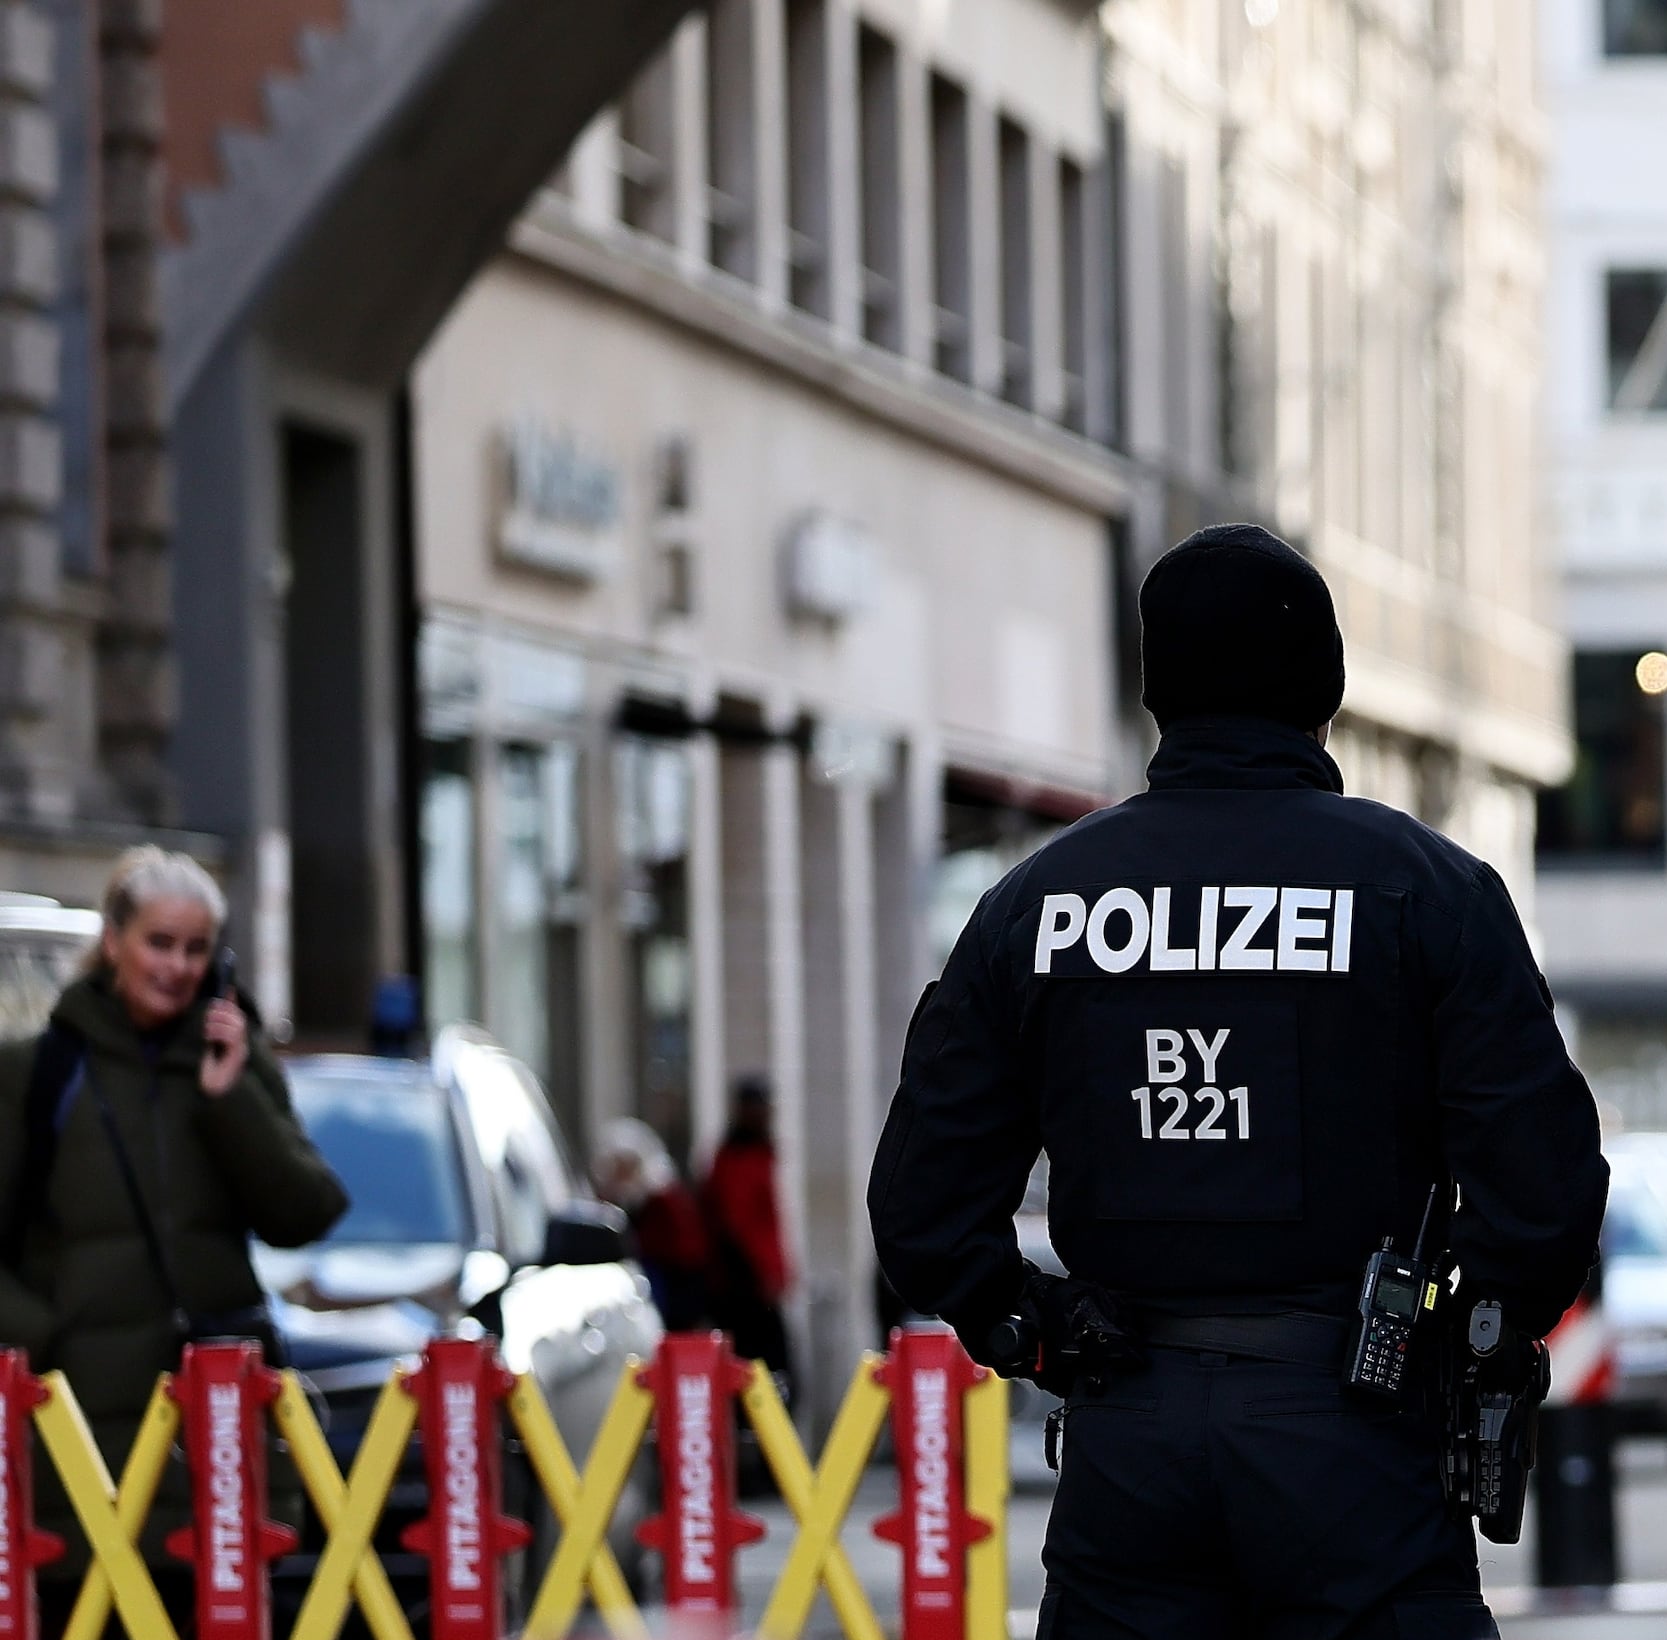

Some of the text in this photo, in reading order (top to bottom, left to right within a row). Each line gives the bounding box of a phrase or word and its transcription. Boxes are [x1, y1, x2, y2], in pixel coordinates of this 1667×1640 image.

[1033, 886, 1354, 974] POLIZEI
[1130, 1086, 1250, 1140] 1221
[1145, 1028, 1231, 1084] BY
[209, 1384, 243, 1591] PITAGONE
[445, 1383, 480, 1590] PITAGONE
[677, 1373, 714, 1583] PITAGONE
[913, 1368, 949, 1577] PITAGONE
